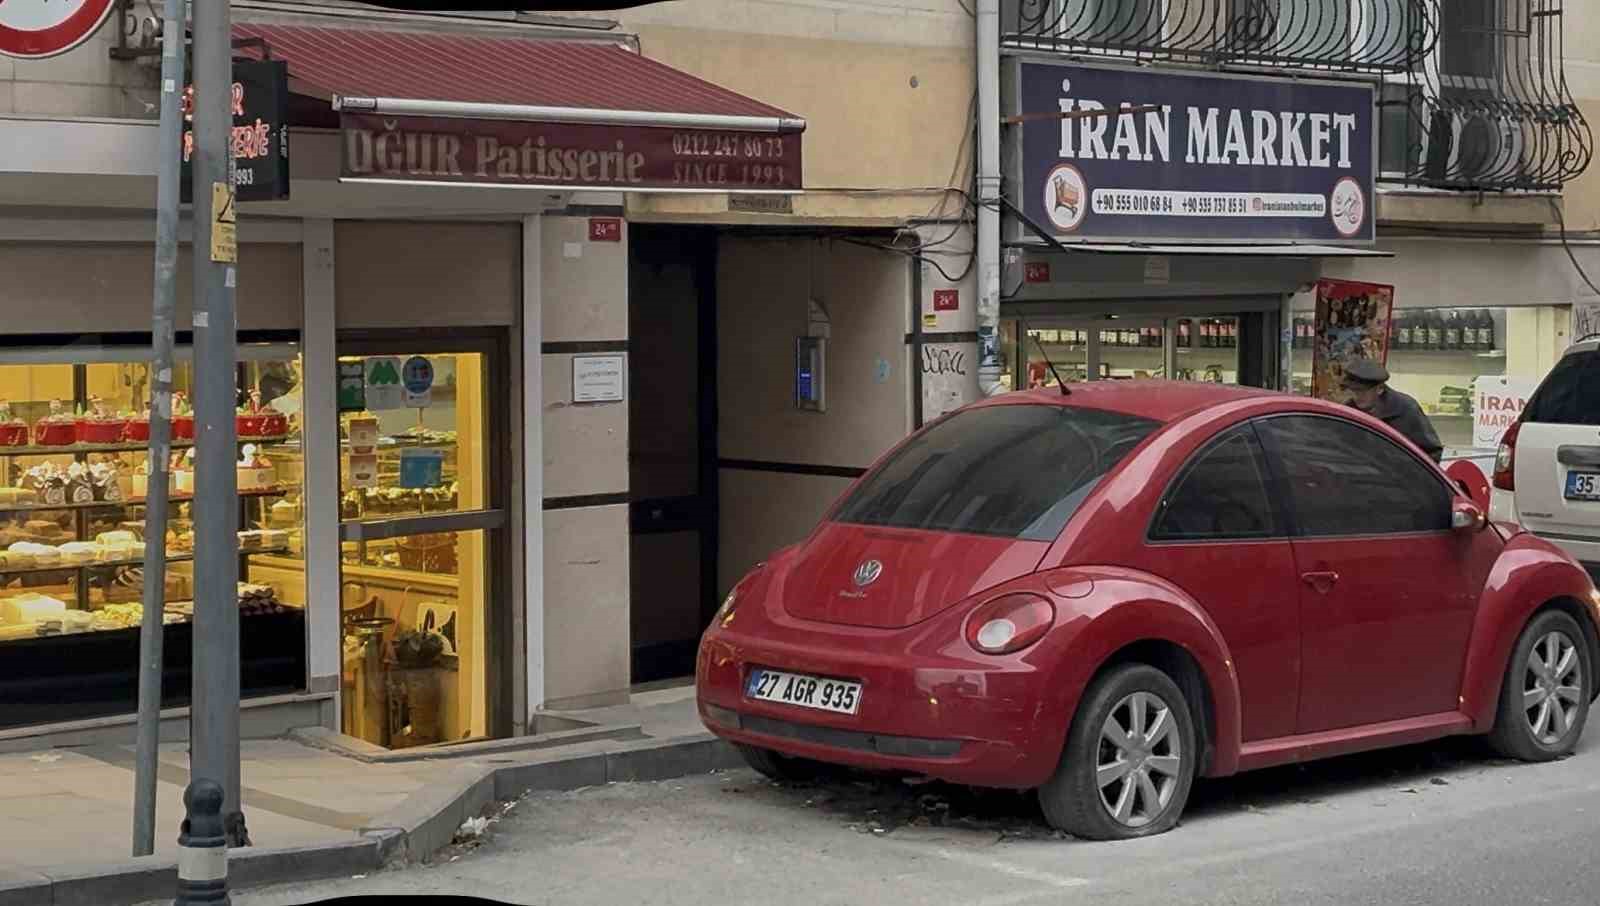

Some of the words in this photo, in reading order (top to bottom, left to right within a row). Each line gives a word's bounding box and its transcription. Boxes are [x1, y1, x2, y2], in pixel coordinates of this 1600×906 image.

[1058, 79, 1171, 162] İRAN
[1185, 106, 1356, 168] MARKET
[673, 134, 709, 155] 0212
[713, 135, 738, 156] 247
[744, 136, 762, 157] 80
[765, 137, 784, 157] 73
[474, 135, 645, 183] Patisserie
[236, 167, 254, 185] 993
[673, 161, 728, 184] SINCE
[742, 164, 784, 185] 1993
[1096, 194, 1114, 210] +90
[1116, 195, 1131, 210] 555
[1133, 195, 1148, 211] 010
[1150, 196, 1160, 211] 68
[1162, 196, 1173, 211] 84
[1182, 197, 1197, 212] +90
[1479, 415, 1516, 427] MARK
[1575, 476, 1595, 494] 35
[757, 673, 780, 697] 27
[783, 676, 817, 704] AGR
[821, 683, 857, 710] 935
